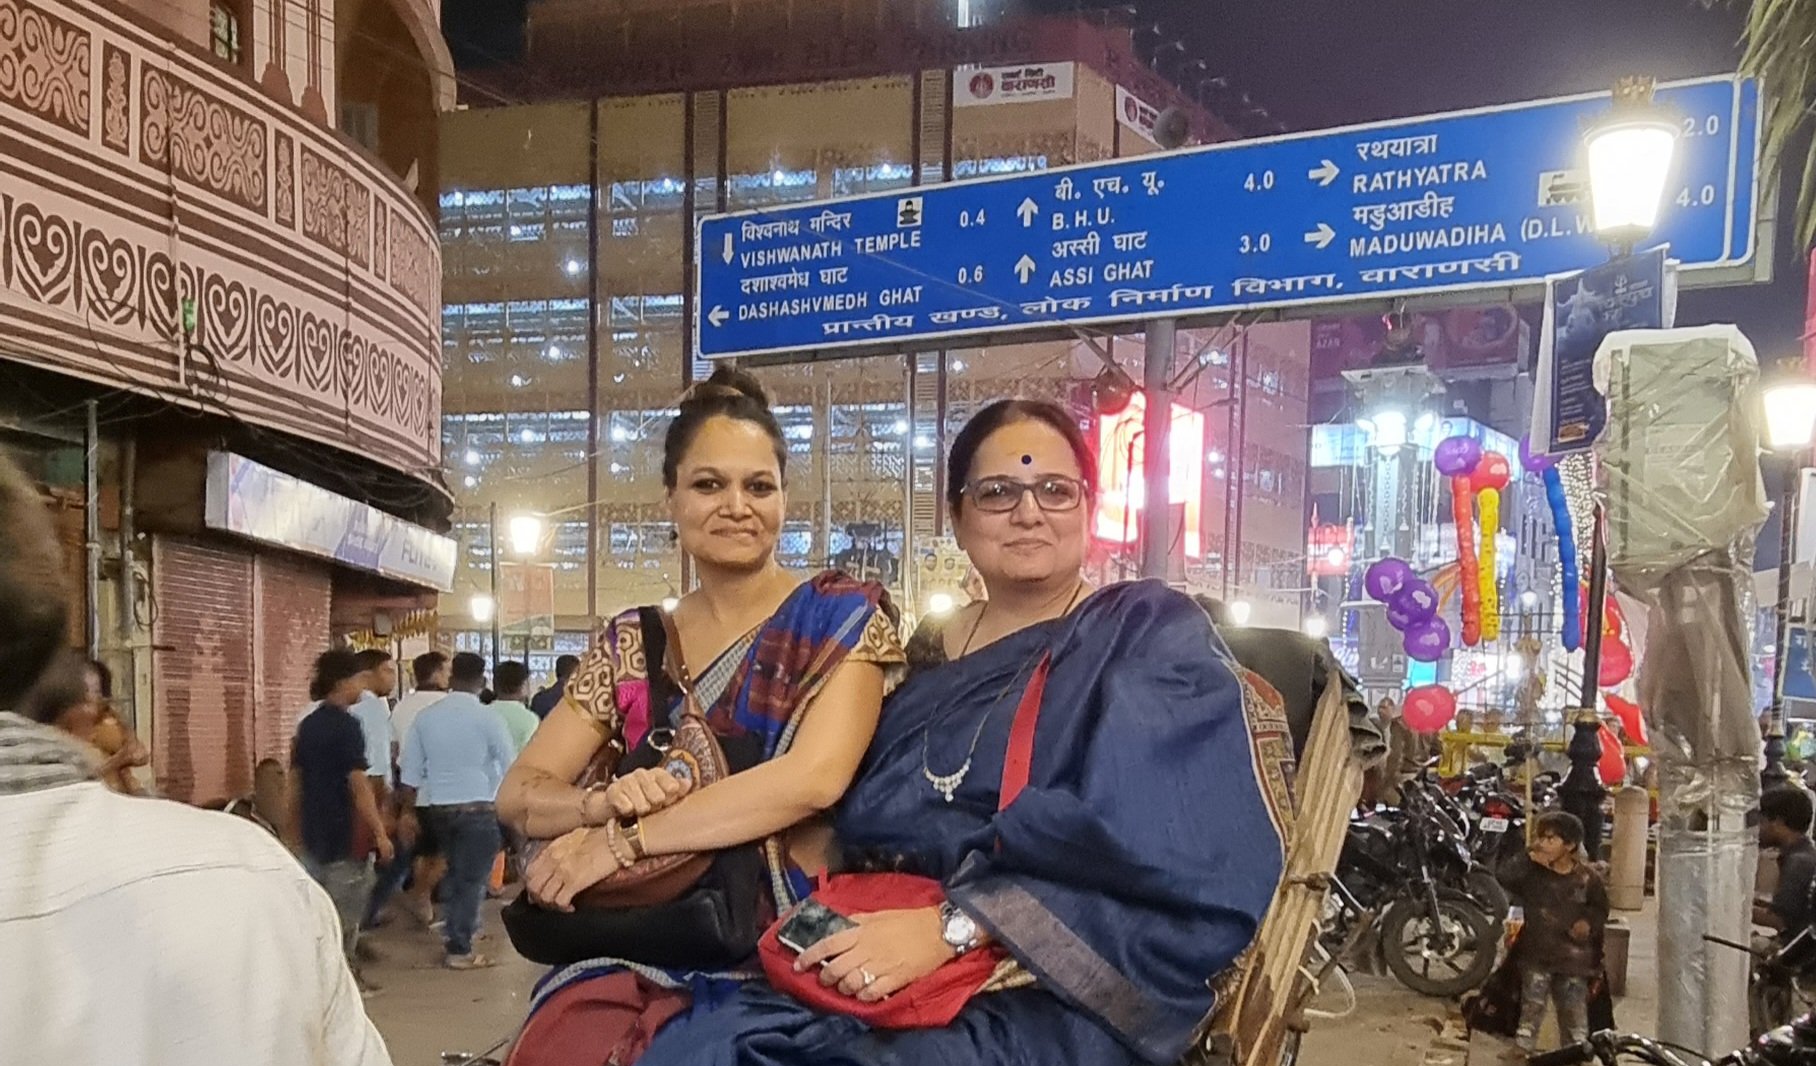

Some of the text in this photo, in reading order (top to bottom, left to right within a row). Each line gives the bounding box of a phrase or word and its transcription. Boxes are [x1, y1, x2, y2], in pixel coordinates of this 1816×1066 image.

[1682, 114, 1719, 137] 2.0
[1356, 134, 1438, 161] रथयात्रा
[1243, 170, 1275, 193] 4.0
[1352, 159, 1487, 194] RATHYATRA
[1676, 184, 1715, 207] 4.0
[959, 208, 985, 228] 0.4
[1352, 190, 1455, 231] मडुआडीह
[741, 209, 852, 243] विश्वनाथ मन्दिर
[1350, 223, 1506, 257] MADUWADIHA
[740, 230, 921, 269] VISHWANATH TEMPLE
[1051, 230, 1149, 259] अस्सी घाट
[1239, 233, 1271, 254] 3.0
[740, 266, 849, 295] दशाश्वमेध घाट
[957, 265, 984, 284] 0.6
[1049, 259, 1154, 288] ASSI GHAT
[738, 285, 923, 321] DASHASHVMEDH GHAT
[821, 313, 915, 335] प्रान्तीय
[1019, 296, 1093, 315] लोक
[1109, 283, 1215, 308] निर्माण
[1231, 273, 1344, 297] विभाग,
[1359, 251, 1523, 284] वाराणसी
